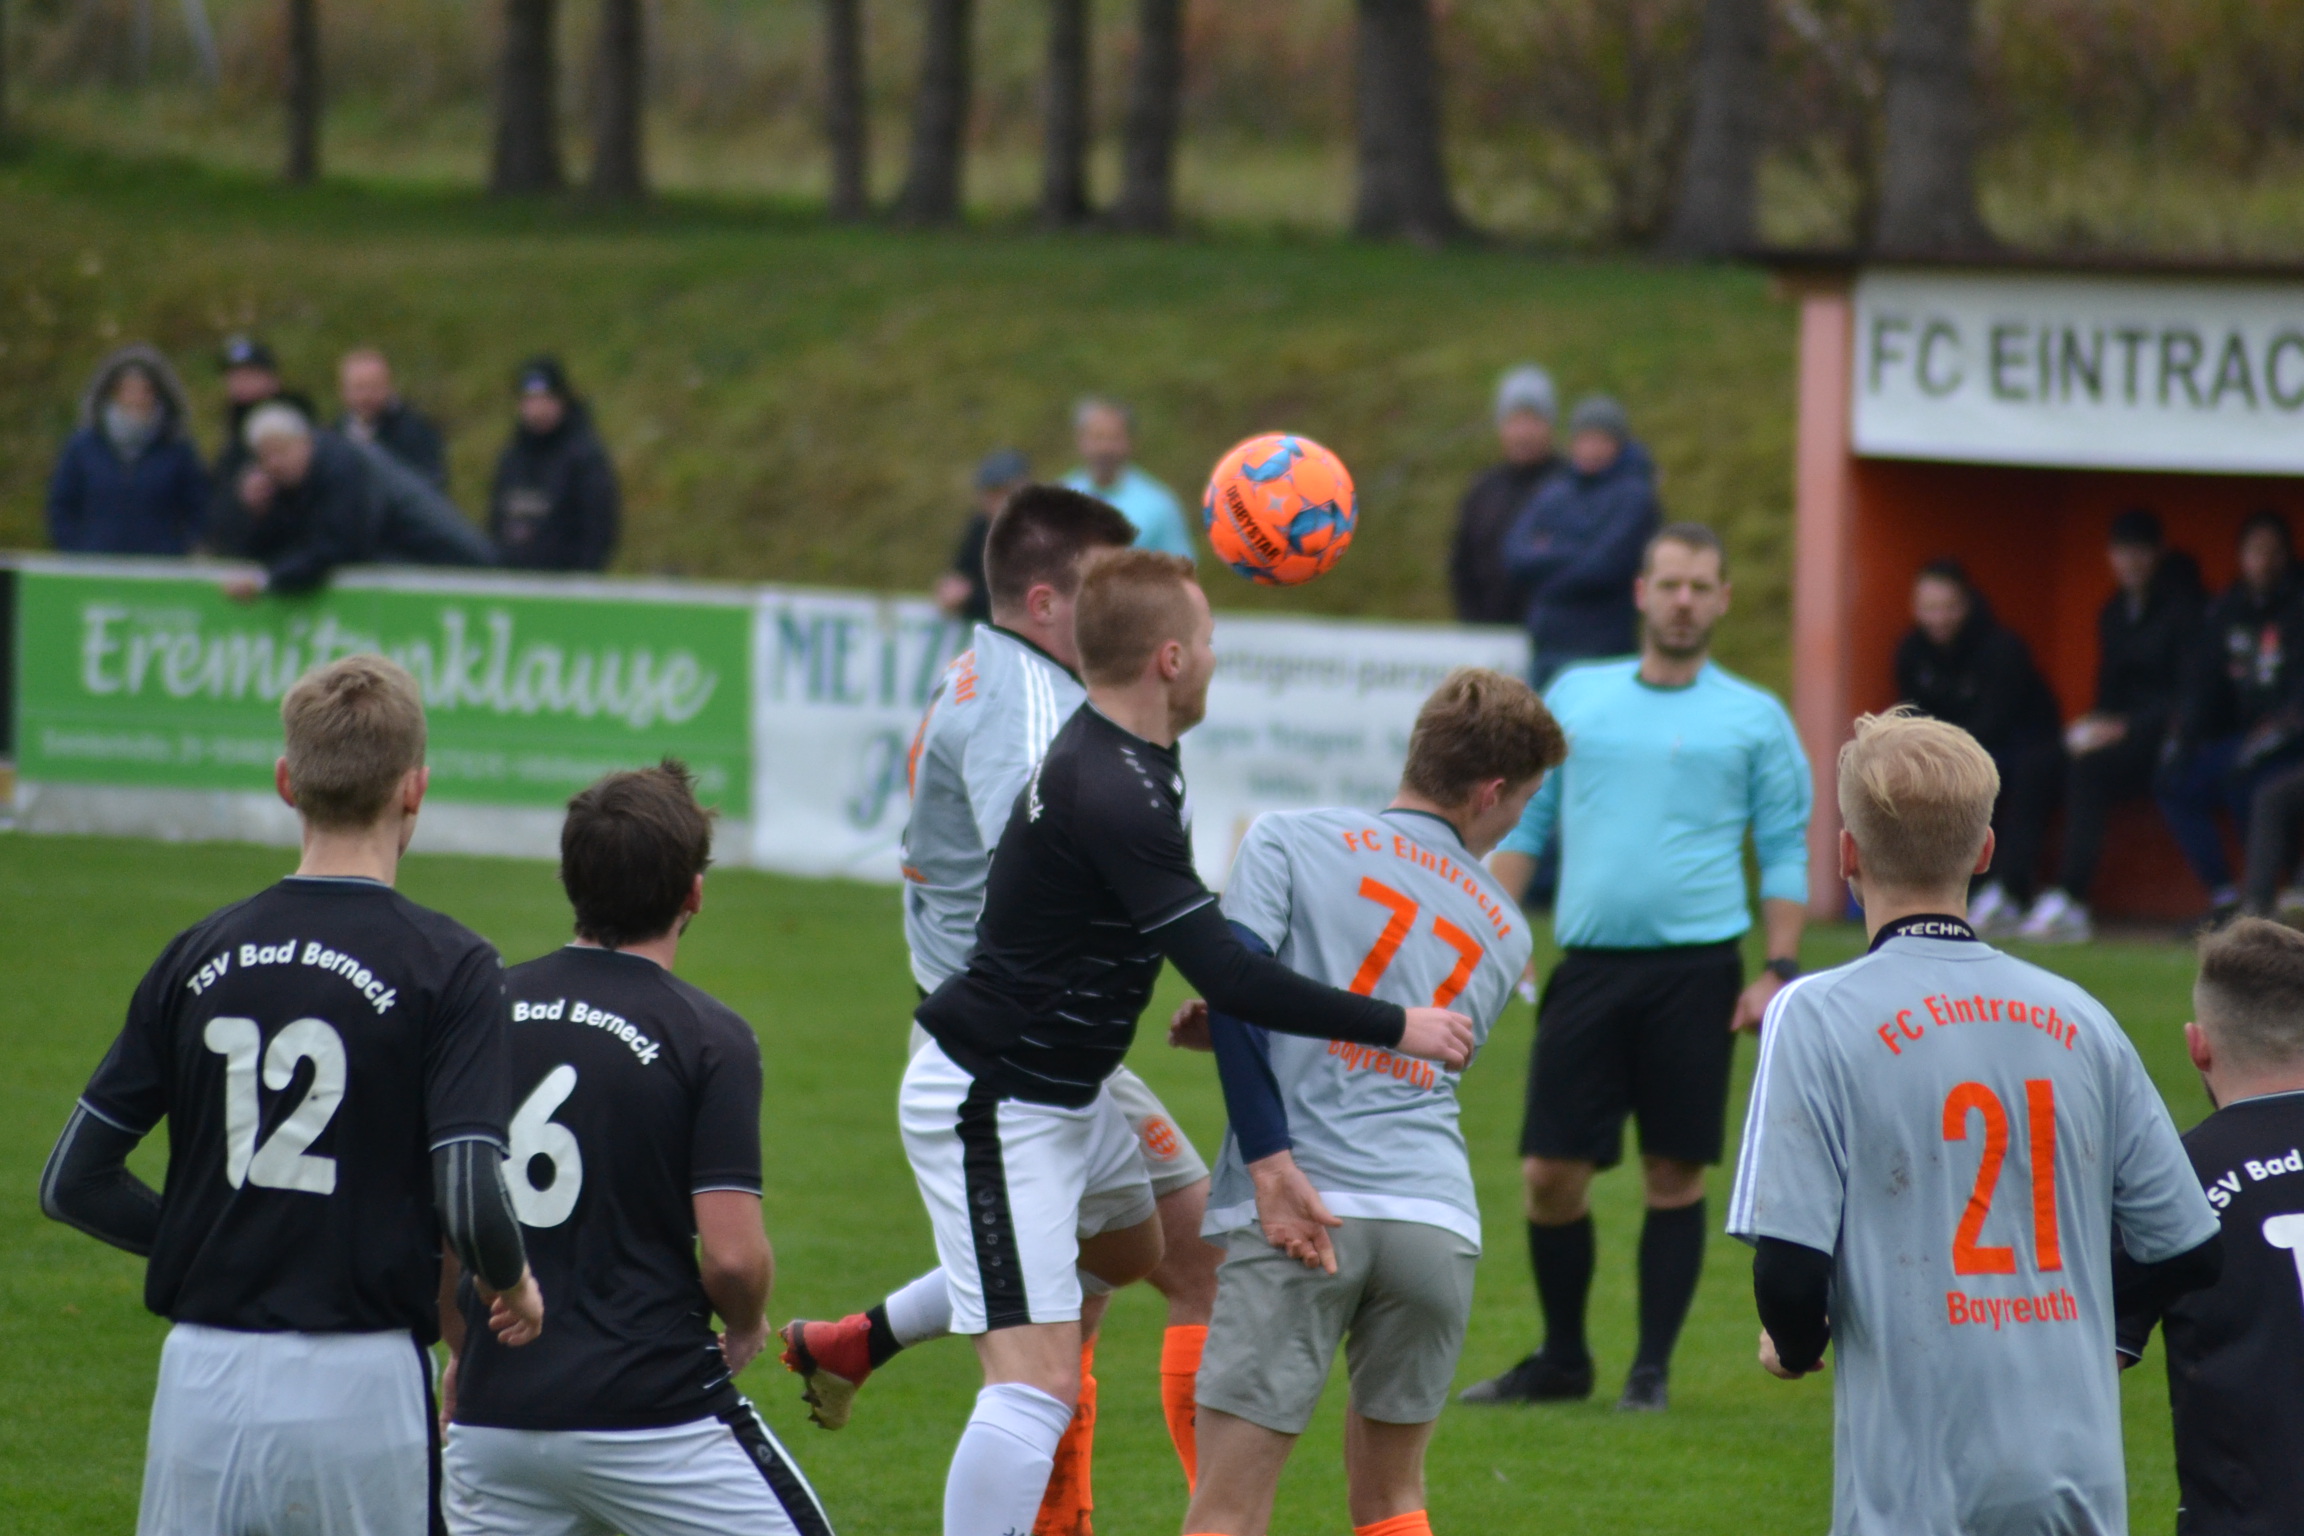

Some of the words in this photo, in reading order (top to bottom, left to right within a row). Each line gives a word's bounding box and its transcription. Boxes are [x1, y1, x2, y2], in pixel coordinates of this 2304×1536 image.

[1867, 314, 1965, 397] FC
[1226, 485, 1281, 561] DERBYSTAR
[1342, 829, 1382, 853] FC
[1392, 834, 1513, 941] Eintracht
[186, 951, 231, 997] TSV
[239, 938, 298, 968] Bad
[301, 941, 397, 1016] Berneck
[1348, 876, 1485, 1010] 77
[512, 998, 567, 1023] Bad
[569, 1002, 661, 1066] Berneck
[1877, 1009, 1925, 1057] FC
[1922, 993, 2079, 1052] Eintracht
[203, 1015, 348, 1196] 12
[500, 1063, 584, 1228] 6
[1942, 1078, 2063, 1275] 21
[2206, 1170, 2242, 1218] SV
[2244, 1148, 2304, 1183] Bad
[1946, 1288, 2079, 1332] Bayreuth
